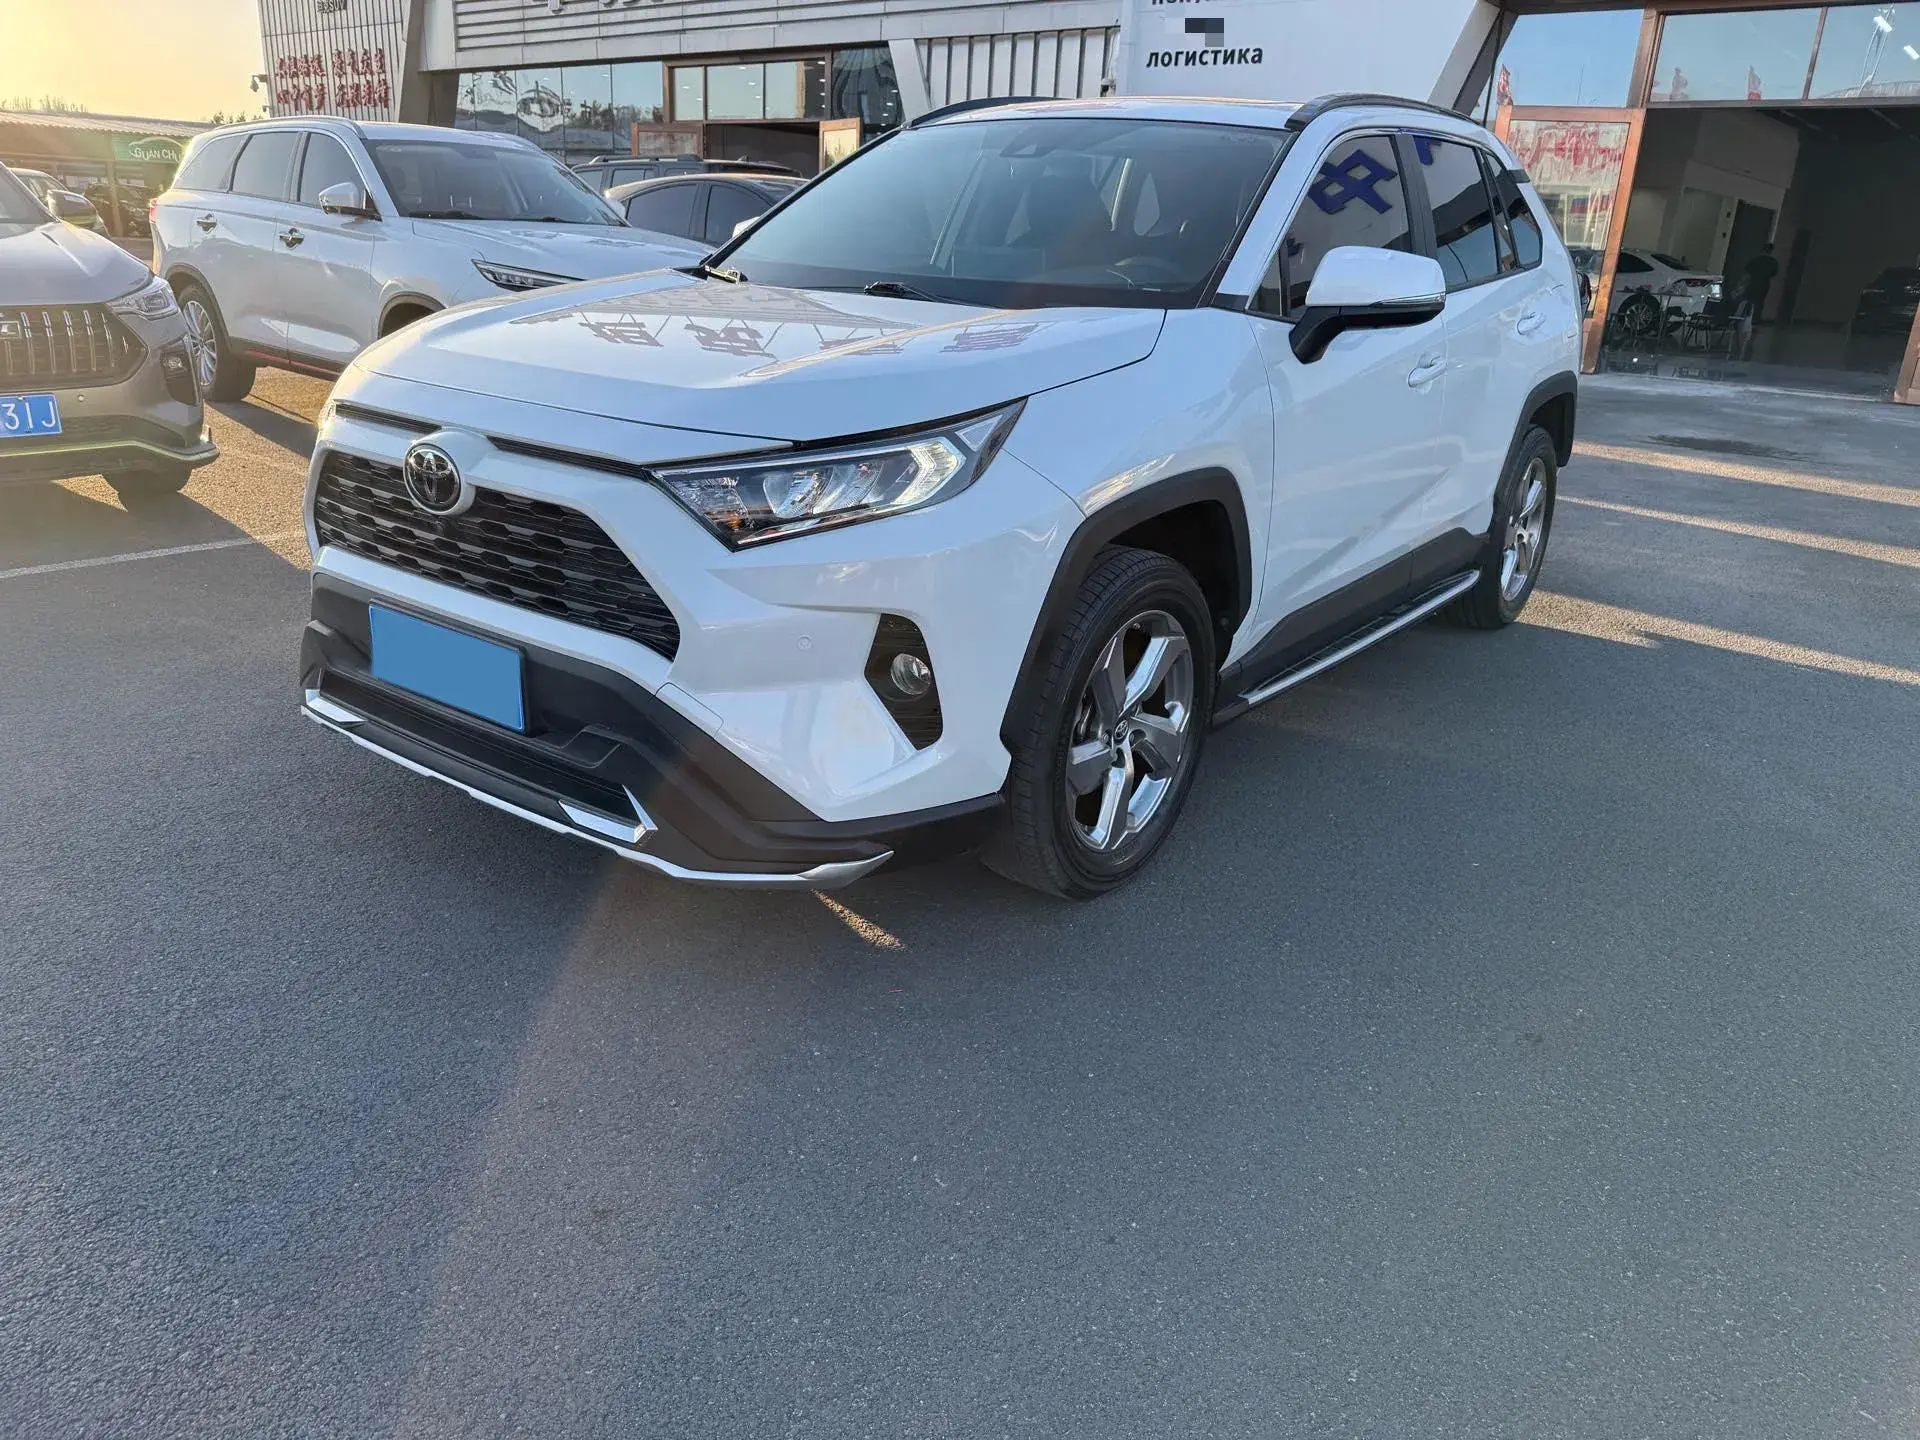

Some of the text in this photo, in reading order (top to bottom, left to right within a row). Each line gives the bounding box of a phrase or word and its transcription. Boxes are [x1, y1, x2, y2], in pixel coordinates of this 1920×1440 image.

[1146, 47, 1263, 68] логистика
[134, 147, 160, 161] GUAN
[1, 400, 56, 430] 31J
